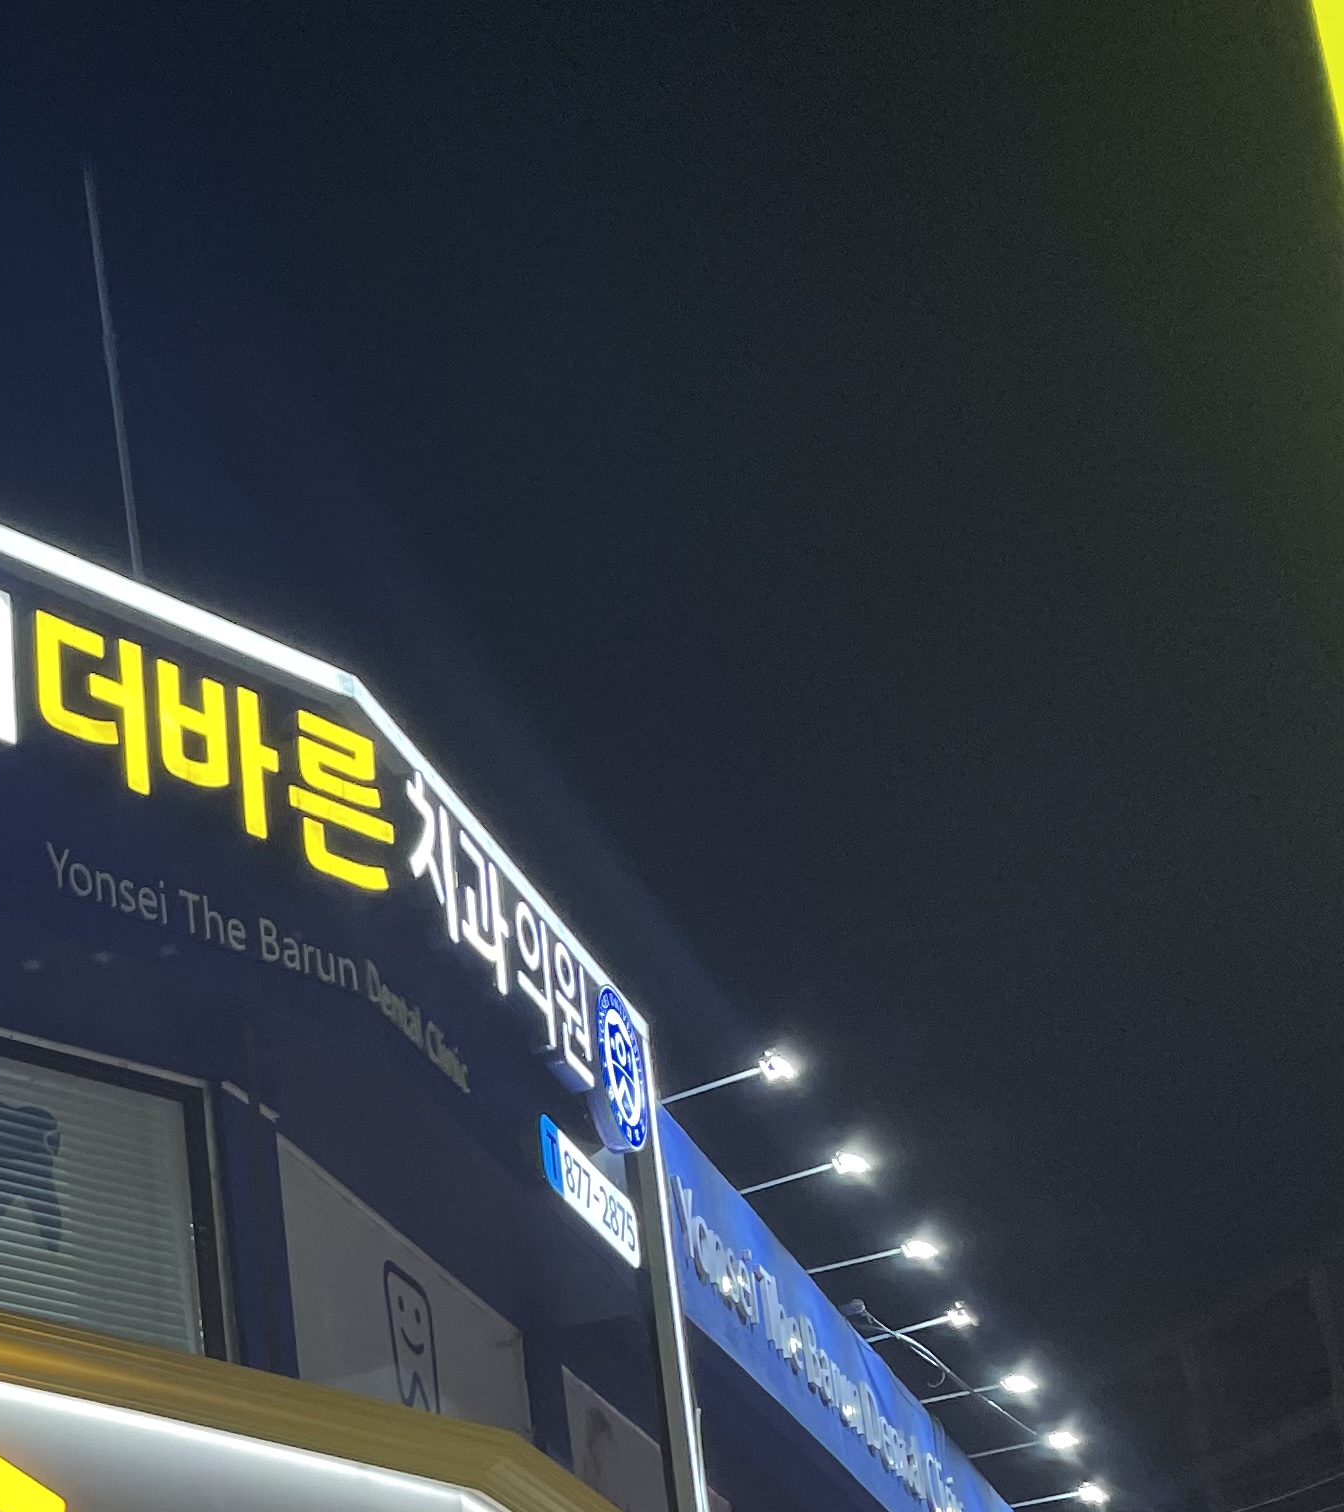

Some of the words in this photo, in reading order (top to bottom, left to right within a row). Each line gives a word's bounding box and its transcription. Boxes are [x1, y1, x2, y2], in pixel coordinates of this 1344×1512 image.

[46, 841, 169, 928] Yonsei
[180, 892, 248, 953] The
[259, 919, 360, 994] Barun
[365, 960, 422, 1046] Dental
[564, 1156, 636, 1254] 877-2875
[670, 1174, 759, 1326] Yonsei
[755, 1262, 804, 1372] The
